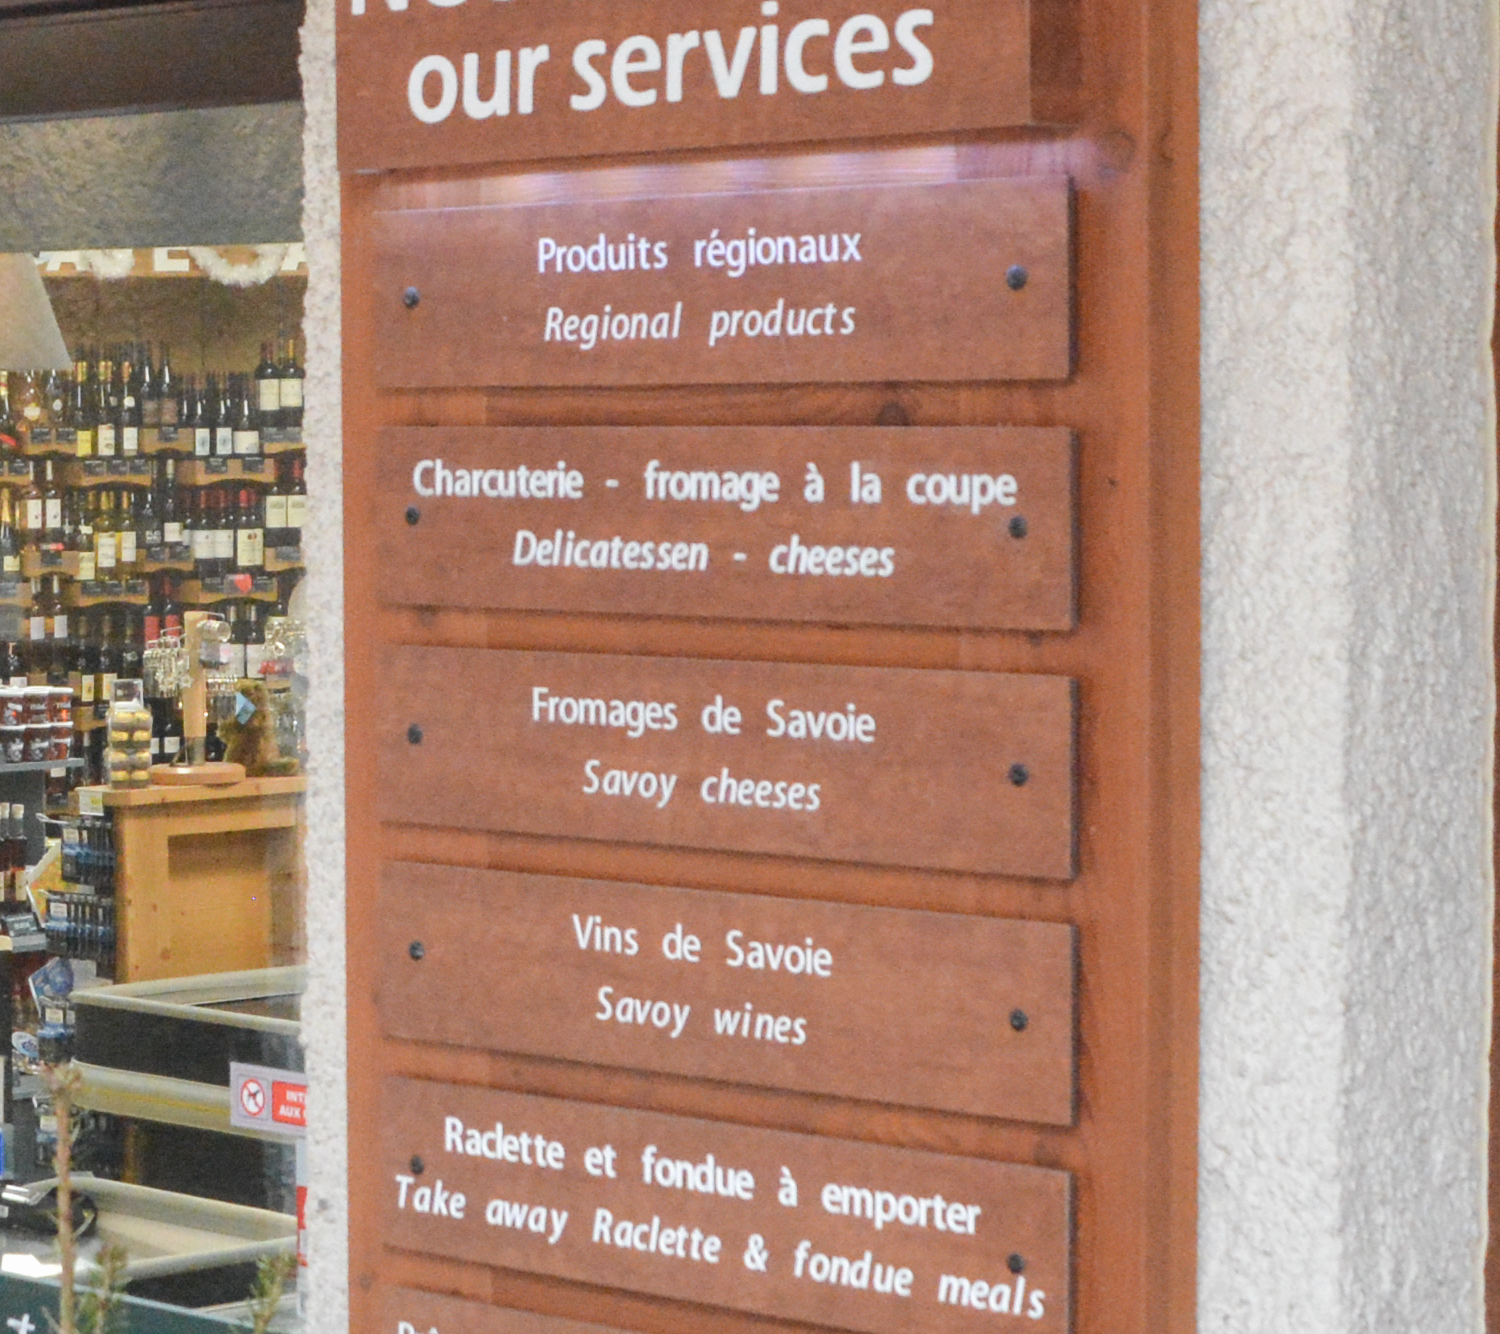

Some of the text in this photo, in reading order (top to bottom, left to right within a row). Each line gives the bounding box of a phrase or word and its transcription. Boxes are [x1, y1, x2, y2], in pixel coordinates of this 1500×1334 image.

[407, 0, 933, 124] our services
[538, 227, 862, 278] Produits régionaux
[544, 299, 855, 350] Regional products
[413, 459, 1017, 515] Charcuterie - fromage à la coupe
[513, 529, 895, 577] Delicatessen - cheeses
[532, 687, 875, 743] Fromages de Savoie
[583, 759, 820, 811] Savoy cheeses
[572, 914, 833, 977] Vins de Savoie
[596, 986, 806, 1045] Savoy wines
[445, 1116, 981, 1234] Raclette et fondue à emporter
[395, 1174, 1045, 1319] Take away Raclette & fondue meals
